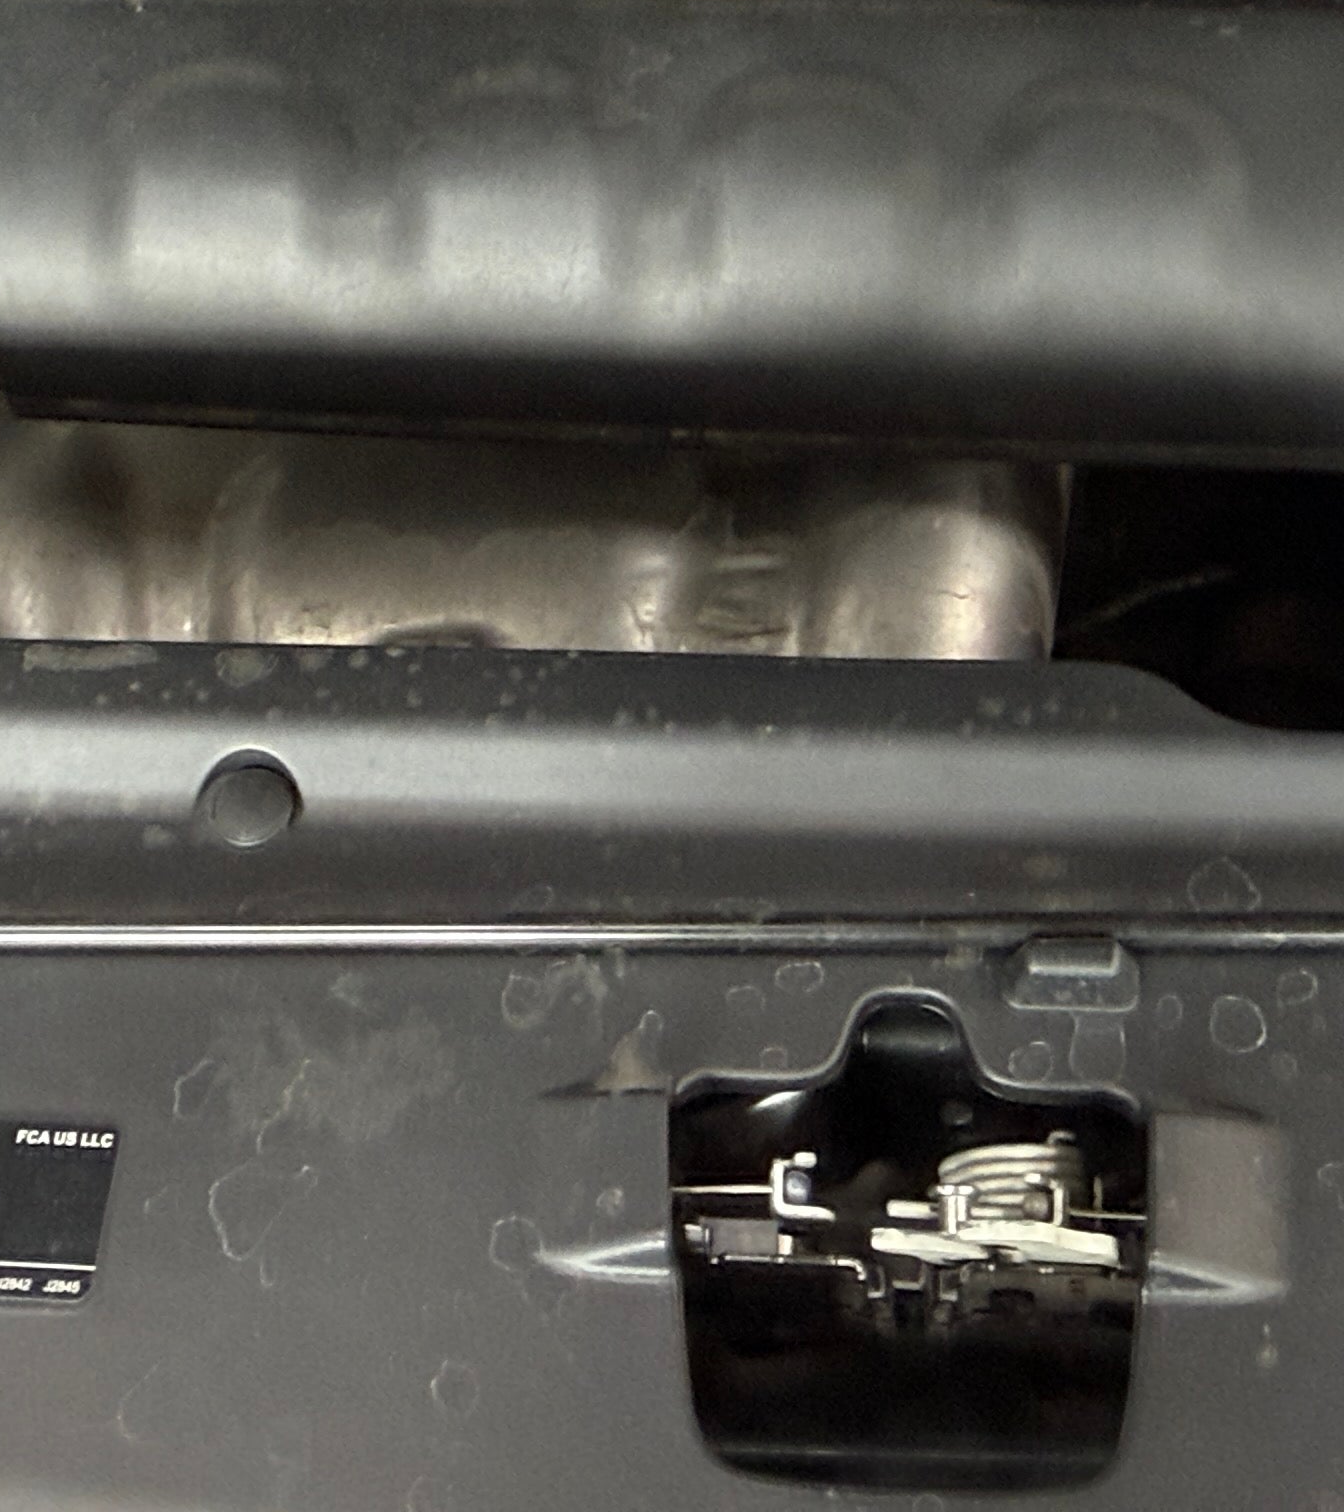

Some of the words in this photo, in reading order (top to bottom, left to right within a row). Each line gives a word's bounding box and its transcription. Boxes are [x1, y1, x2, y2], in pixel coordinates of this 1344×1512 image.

[15, 1129, 51, 1146] FCA
[53, 1130, 78, 1147] US
[80, 1132, 115, 1149] LLC
